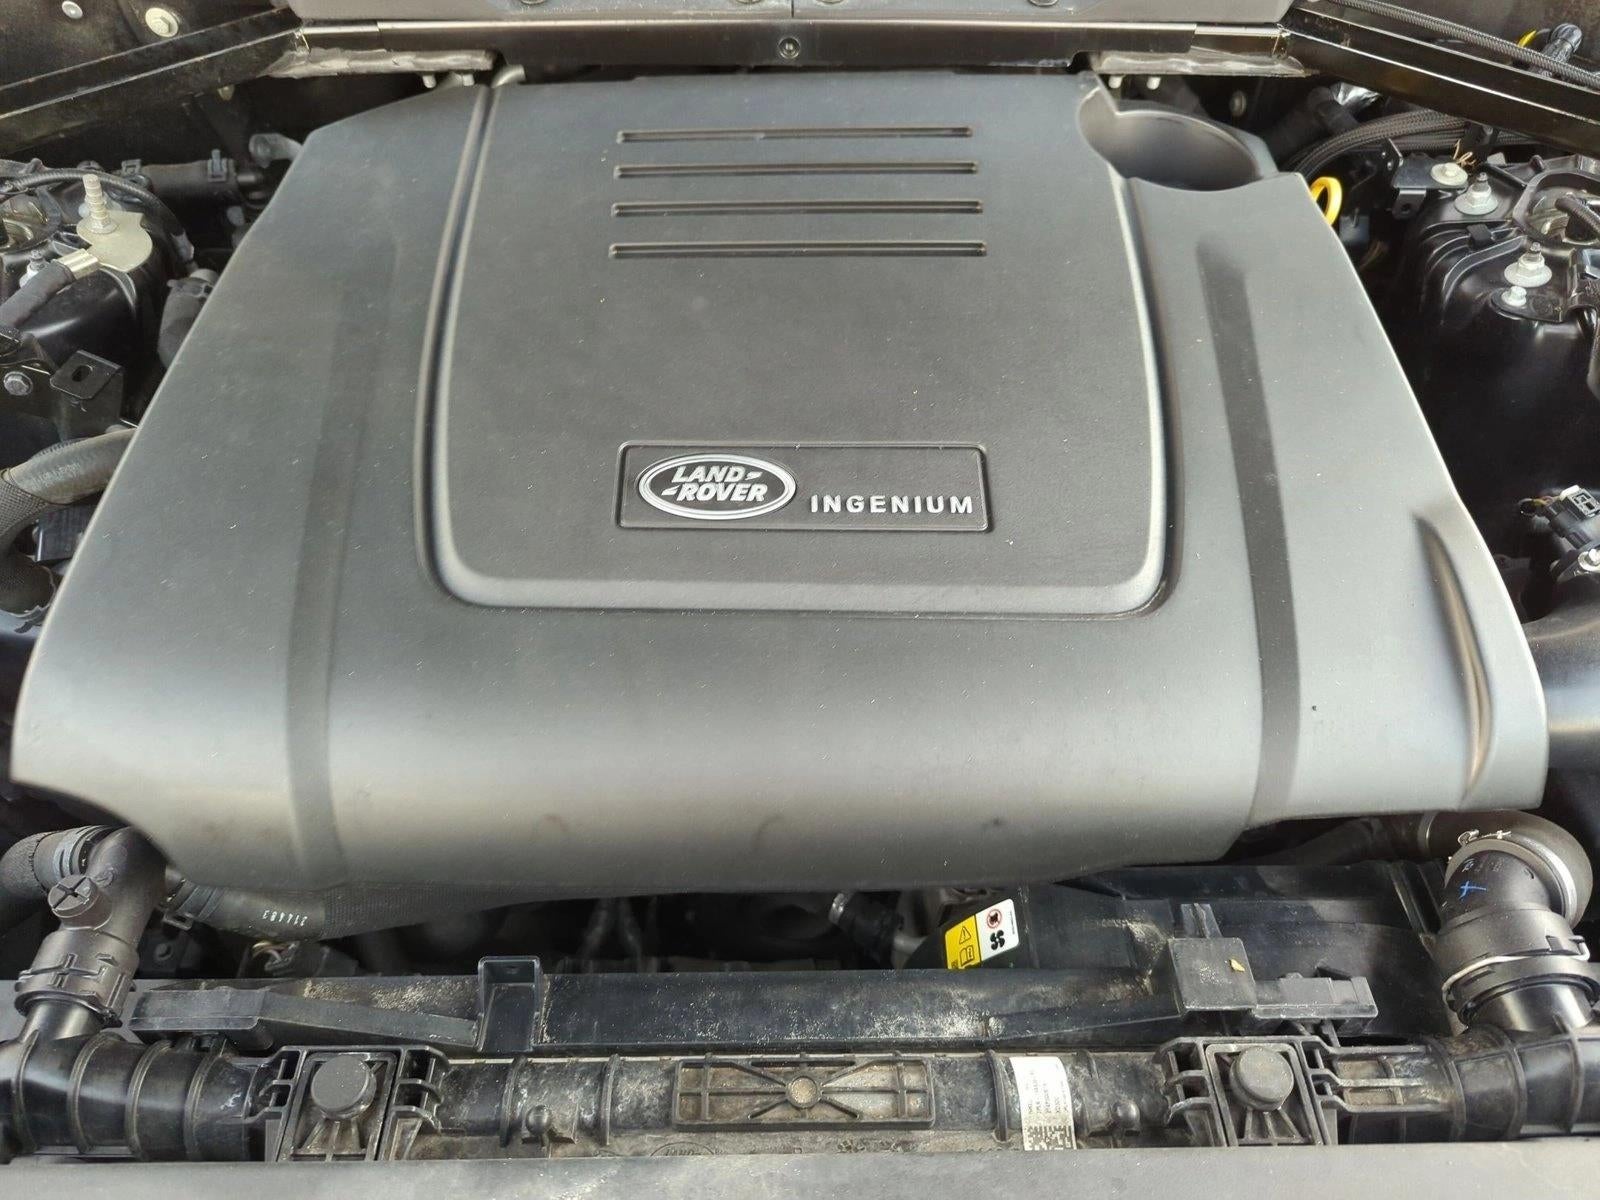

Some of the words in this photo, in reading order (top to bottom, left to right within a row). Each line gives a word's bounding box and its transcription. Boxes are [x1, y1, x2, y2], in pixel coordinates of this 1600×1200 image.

[671, 465, 746, 483] LAND
[676, 482, 768, 502] ROVER
[810, 494, 973, 514] INGENIUM
